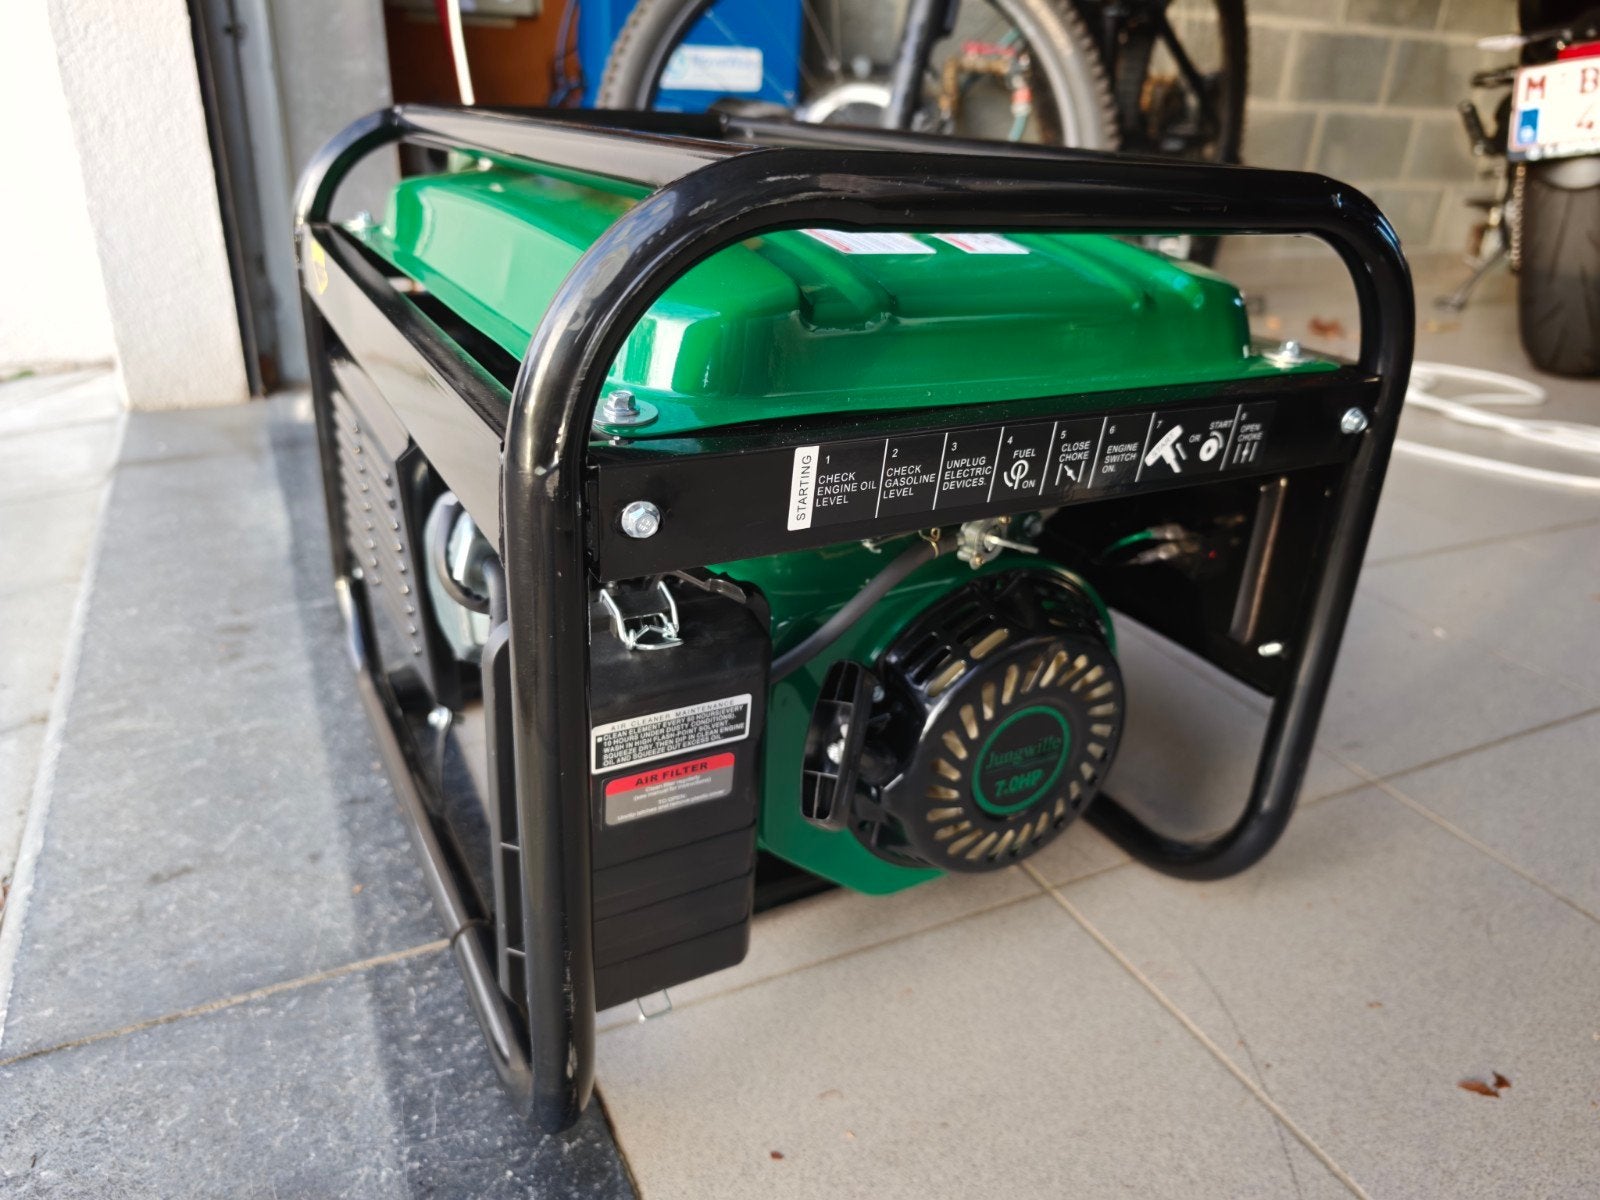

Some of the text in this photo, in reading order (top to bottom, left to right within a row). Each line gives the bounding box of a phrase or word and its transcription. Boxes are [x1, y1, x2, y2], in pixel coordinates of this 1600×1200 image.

[1109, 425, 1116, 435] 6
[1208, 419, 1235, 430] START
[1239, 422, 1262, 434] OPEN
[1006, 435, 1014, 445] 4
[1060, 430, 1067, 440] 5
[1188, 433, 1202, 443] OR
[1237, 430, 1264, 443] CHOKE
[891, 448, 899, 458] 2
[951, 441, 958, 452] 3
[1061, 440, 1091, 453] CLOSE
[1106, 441, 1139, 455] ENGINE
[825, 455, 831, 465] 1
[1013, 448, 1036, 459] FUEL
[1058, 450, 1089, 464] CHOKE
[1104, 452, 1137, 465] SWITCH
[946, 456, 987, 470] UNPLUG
[886, 464, 922, 477] CHECK
[944, 465, 993, 481] ELECTRIC
[818, 472, 856, 485] CHECK
[884, 473, 936, 489] GASOLINE
[1021, 479, 1036, 489] ON
[796, 454, 812, 521] STARTING
[817, 480, 877, 496] ENGINE OIL
[882, 487, 914, 500] LEVEL
[815, 495, 849, 508] LEVEL
[611, 700, 735, 731] AIR CLEANER MAINTENANCE
[603, 730, 628, 741] CLEAN
[629, 722, 662, 735] ELEMENT
[613, 734, 639, 746] HOURS
[640, 728, 665, 739] UNDER
[635, 762, 709, 786] AIR FILTER
